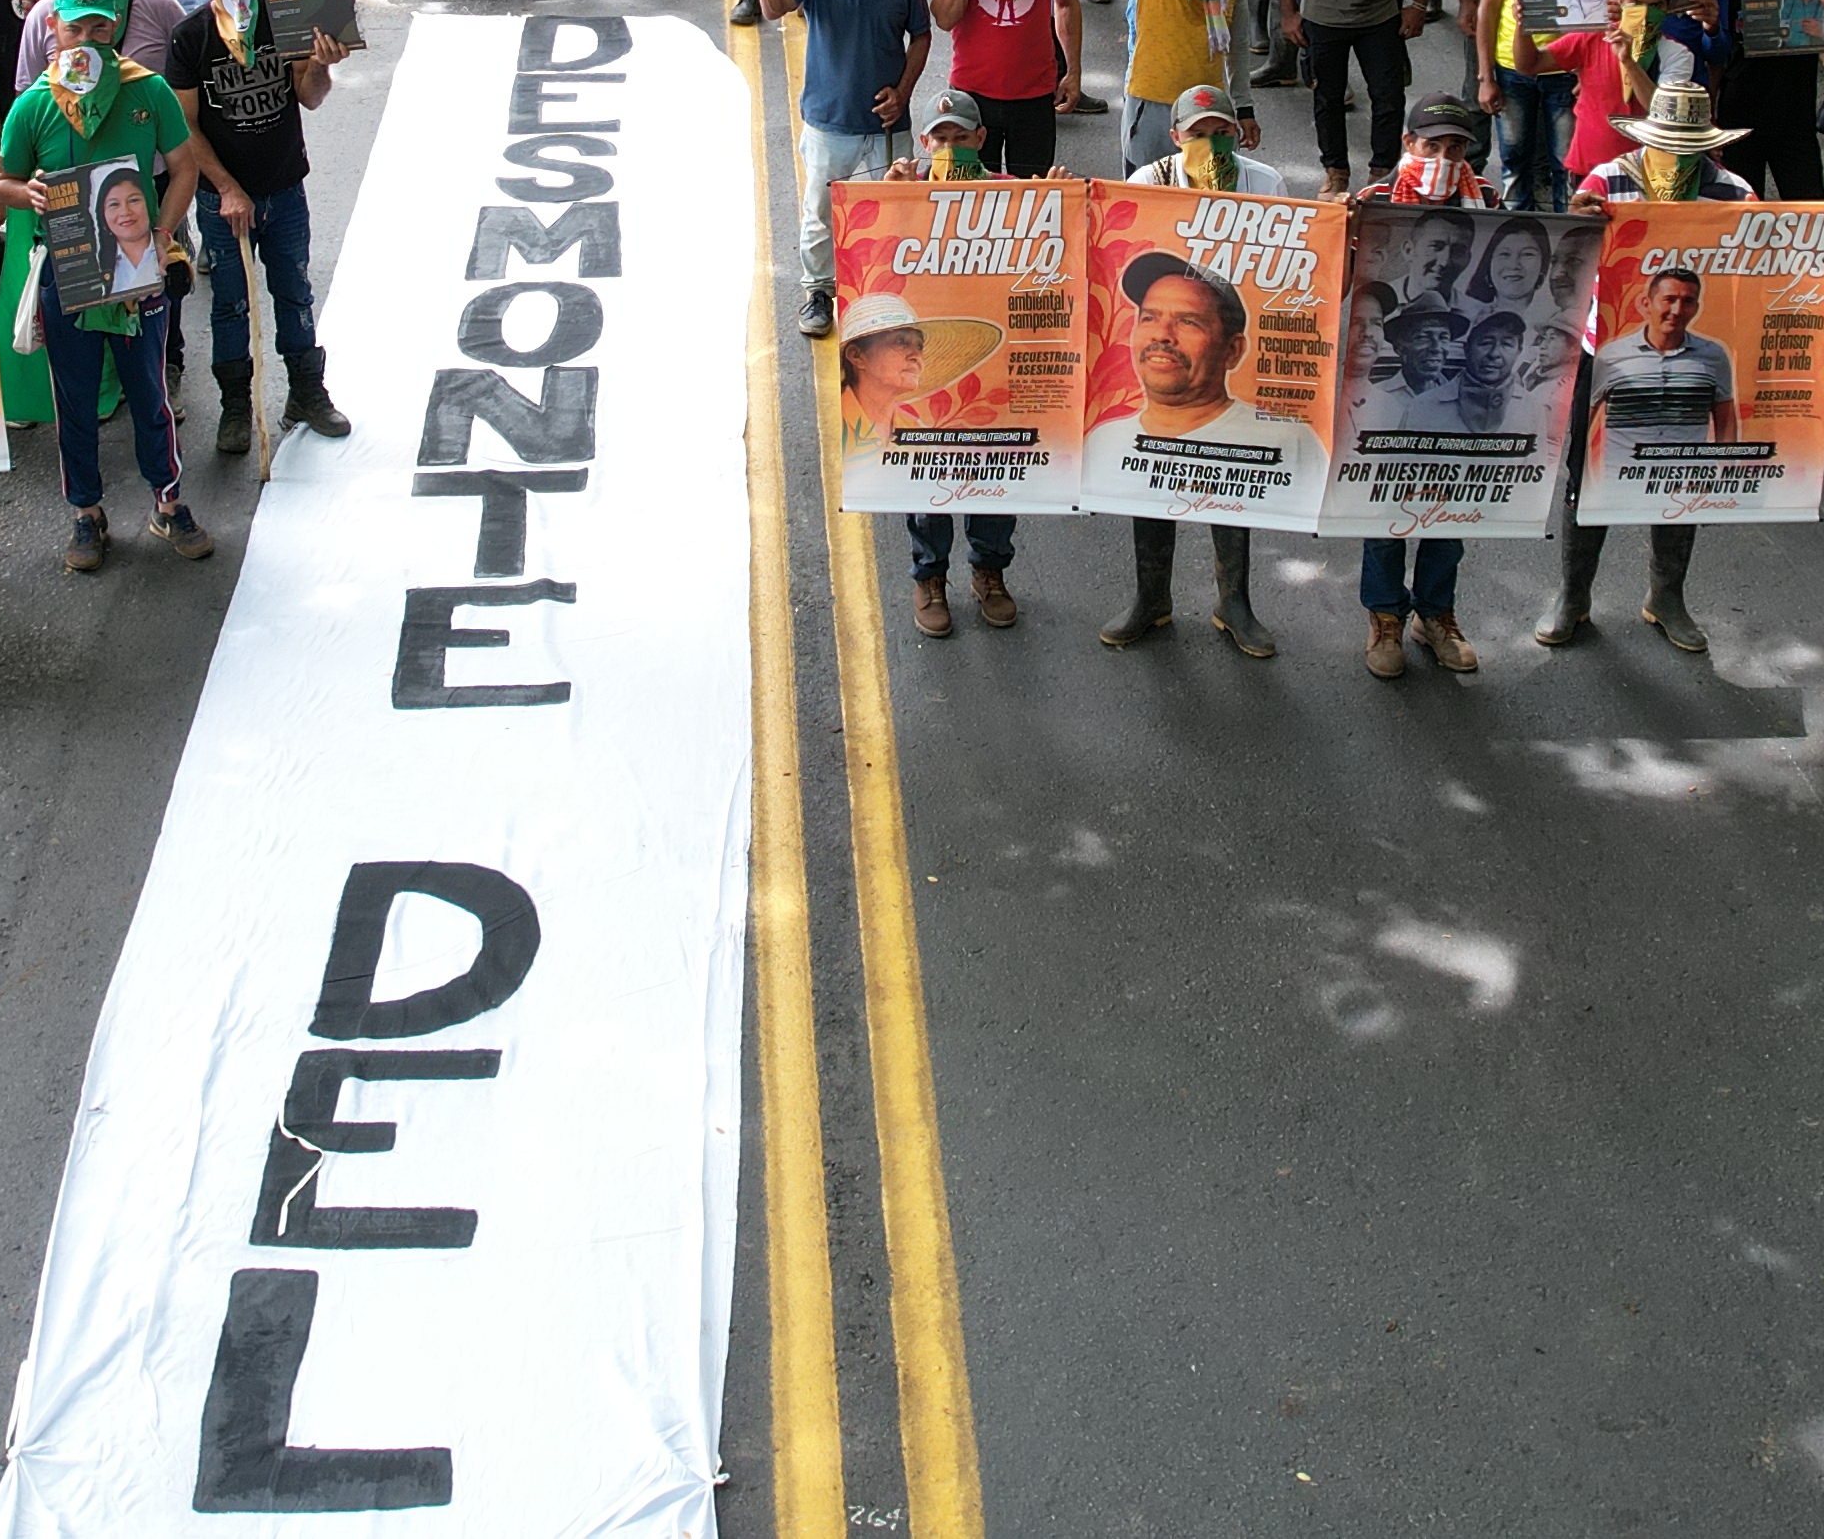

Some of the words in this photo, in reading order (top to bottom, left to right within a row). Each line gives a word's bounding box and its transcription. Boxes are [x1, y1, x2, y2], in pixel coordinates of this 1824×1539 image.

[219, 55, 281, 89] NEW
[65, 100, 102, 120] CNA
[225, 84, 287, 117] YORK
[928, 189, 1063, 240] TULIA
[1176, 197, 1318, 250] JORGE
[892, 237, 1066, 275] CARRILLO
[1184, 238, 1318, 291] TAFUR
[1008, 290, 1065, 312] ambiental
[1068, 296, 1075, 316] y
[1008, 312, 1071, 334] campesina
[1258, 311, 1320, 336] ambiental,
[1258, 335, 1334, 359] recuperador
[1760, 330, 1814, 350] defensor
[392, 15, 634, 710] DESMONTE
[1009, 351, 1081, 364] SECUESTRADA
[1256, 355, 1271, 374] de
[1274, 356, 1321, 378] tierras.
[1758, 351, 1773, 371] de
[1774, 350, 1786, 370] la
[1788, 354, 1812, 371] vida
[1008, 364, 1015, 375] Y
[1016, 364, 1074, 376] ASESINADA
[1256, 386, 1316, 401] ASESINADO
[1754, 390, 1813, 402] ASESINADO
[1418, 437, 1435, 450] DEL
[882, 451, 909, 466] POR
[913, 451, 982, 466] NUESTRAS
[985, 451, 1050, 466] MUERTAS
[910, 466, 925, 481] NI
[929, 466, 947, 481] UN
[951, 466, 1005, 481] MINUTO
[1009, 466, 1027, 481] DE
[1121, 456, 1149, 472] POR
[1152, 460, 1222, 480] NUESTROS
[1225, 467, 1293, 487] MUERTOS
[1337, 463, 1372, 482] POR
[1374, 463, 1462, 483] NUESTROS
[1464, 464, 1546, 484] MUERTOS
[1618, 465, 1646, 480] POR
[1649, 465, 1719, 480] NUESTROS
[1720, 464, 1786, 480] MUERTOS
[1149, 474, 1164, 489] NI
[1167, 476, 1187, 492] UN
[1190, 480, 1245, 498] MINUTO
[1248, 485, 1268, 500] DE
[1369, 483, 1389, 502] NI
[1392, 483, 1415, 503] UN
[1419, 483, 1487, 503] MINUTO
[1489, 484, 1514, 503] DE
[1645, 480, 1661, 494] NI
[1663, 480, 1682, 494] UN
[1685, 479, 1739, 494] MINUTO
[1742, 479, 1761, 494] DE
[192, 860, 542, 1515] DEL
